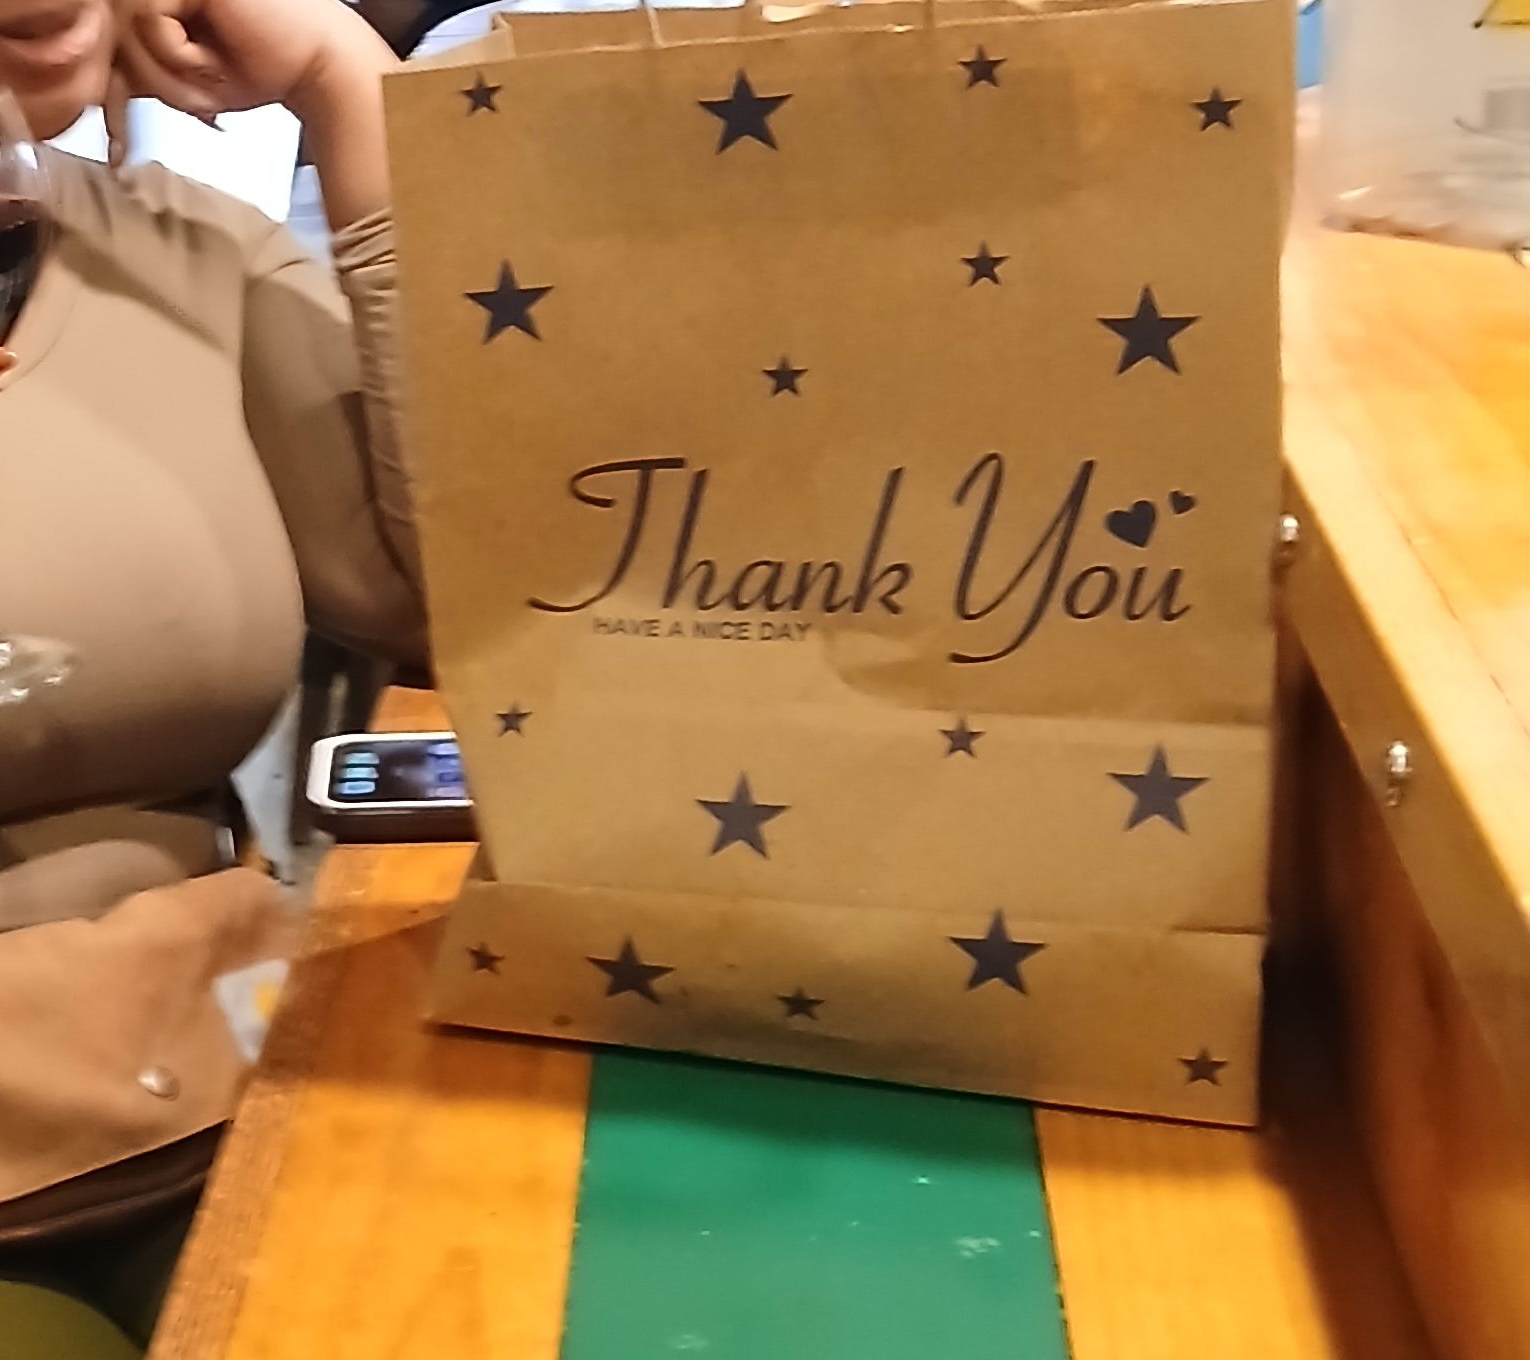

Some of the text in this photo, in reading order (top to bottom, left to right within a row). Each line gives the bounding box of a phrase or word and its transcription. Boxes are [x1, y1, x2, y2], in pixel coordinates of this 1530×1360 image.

[527, 451, 1194, 665] Thank You
[593, 616, 812, 642] HAVE A NICE DAY
